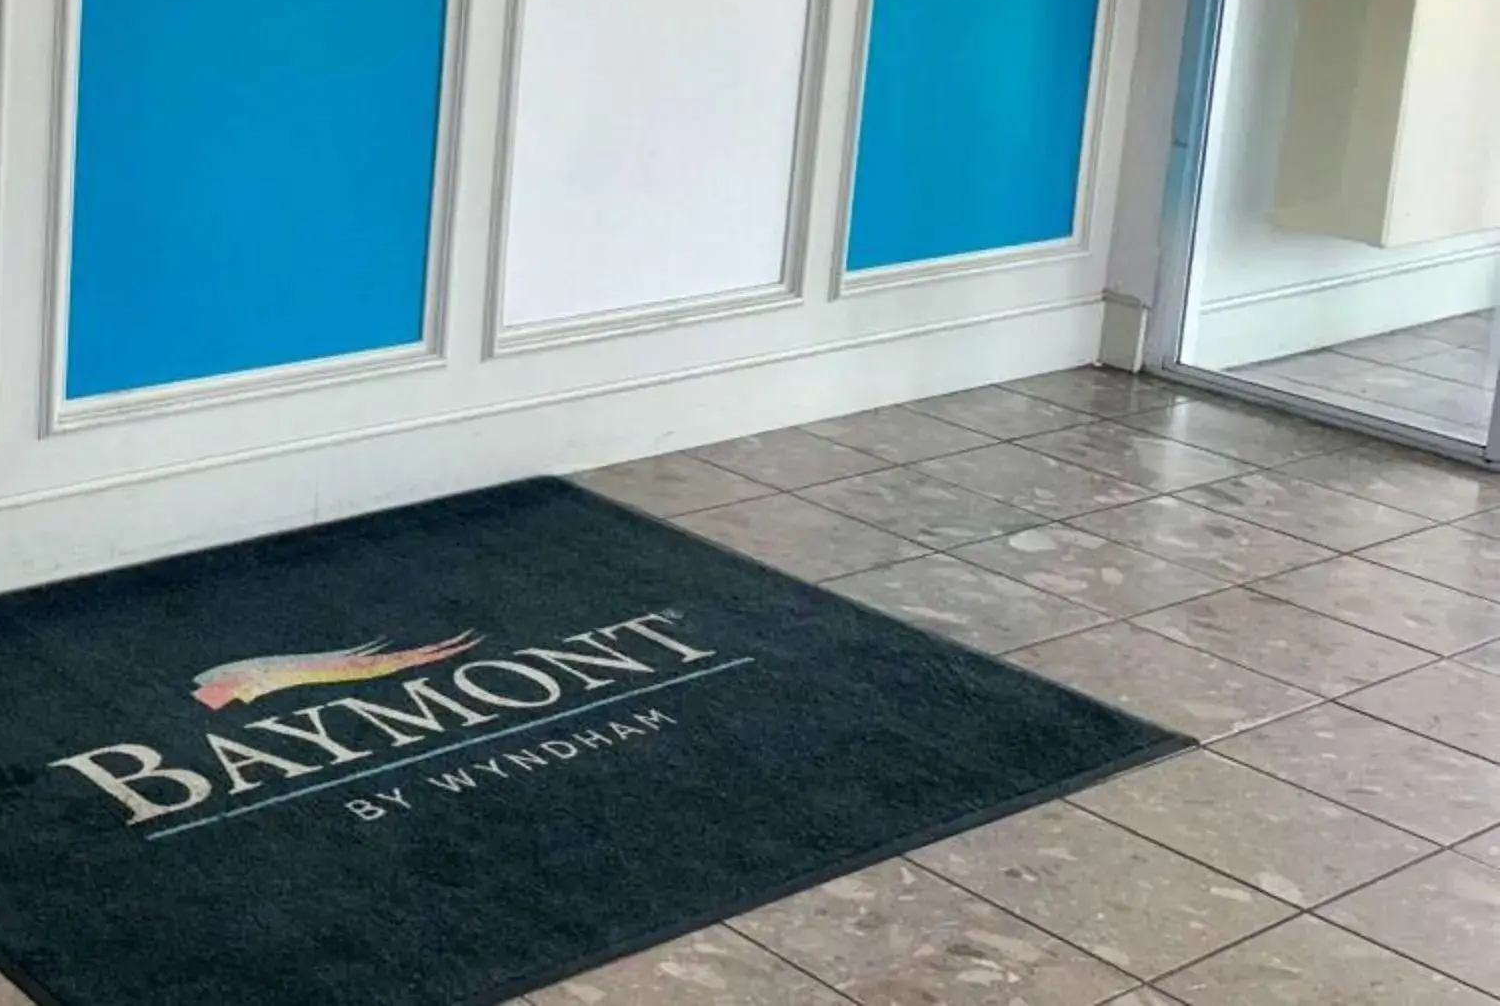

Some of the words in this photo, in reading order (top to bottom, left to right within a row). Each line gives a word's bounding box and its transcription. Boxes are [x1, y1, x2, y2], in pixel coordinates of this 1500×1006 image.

[48, 612, 715, 826] BAYMONT
[343, 786, 414, 824] BY
[430, 707, 677, 797] WYNDHAM
